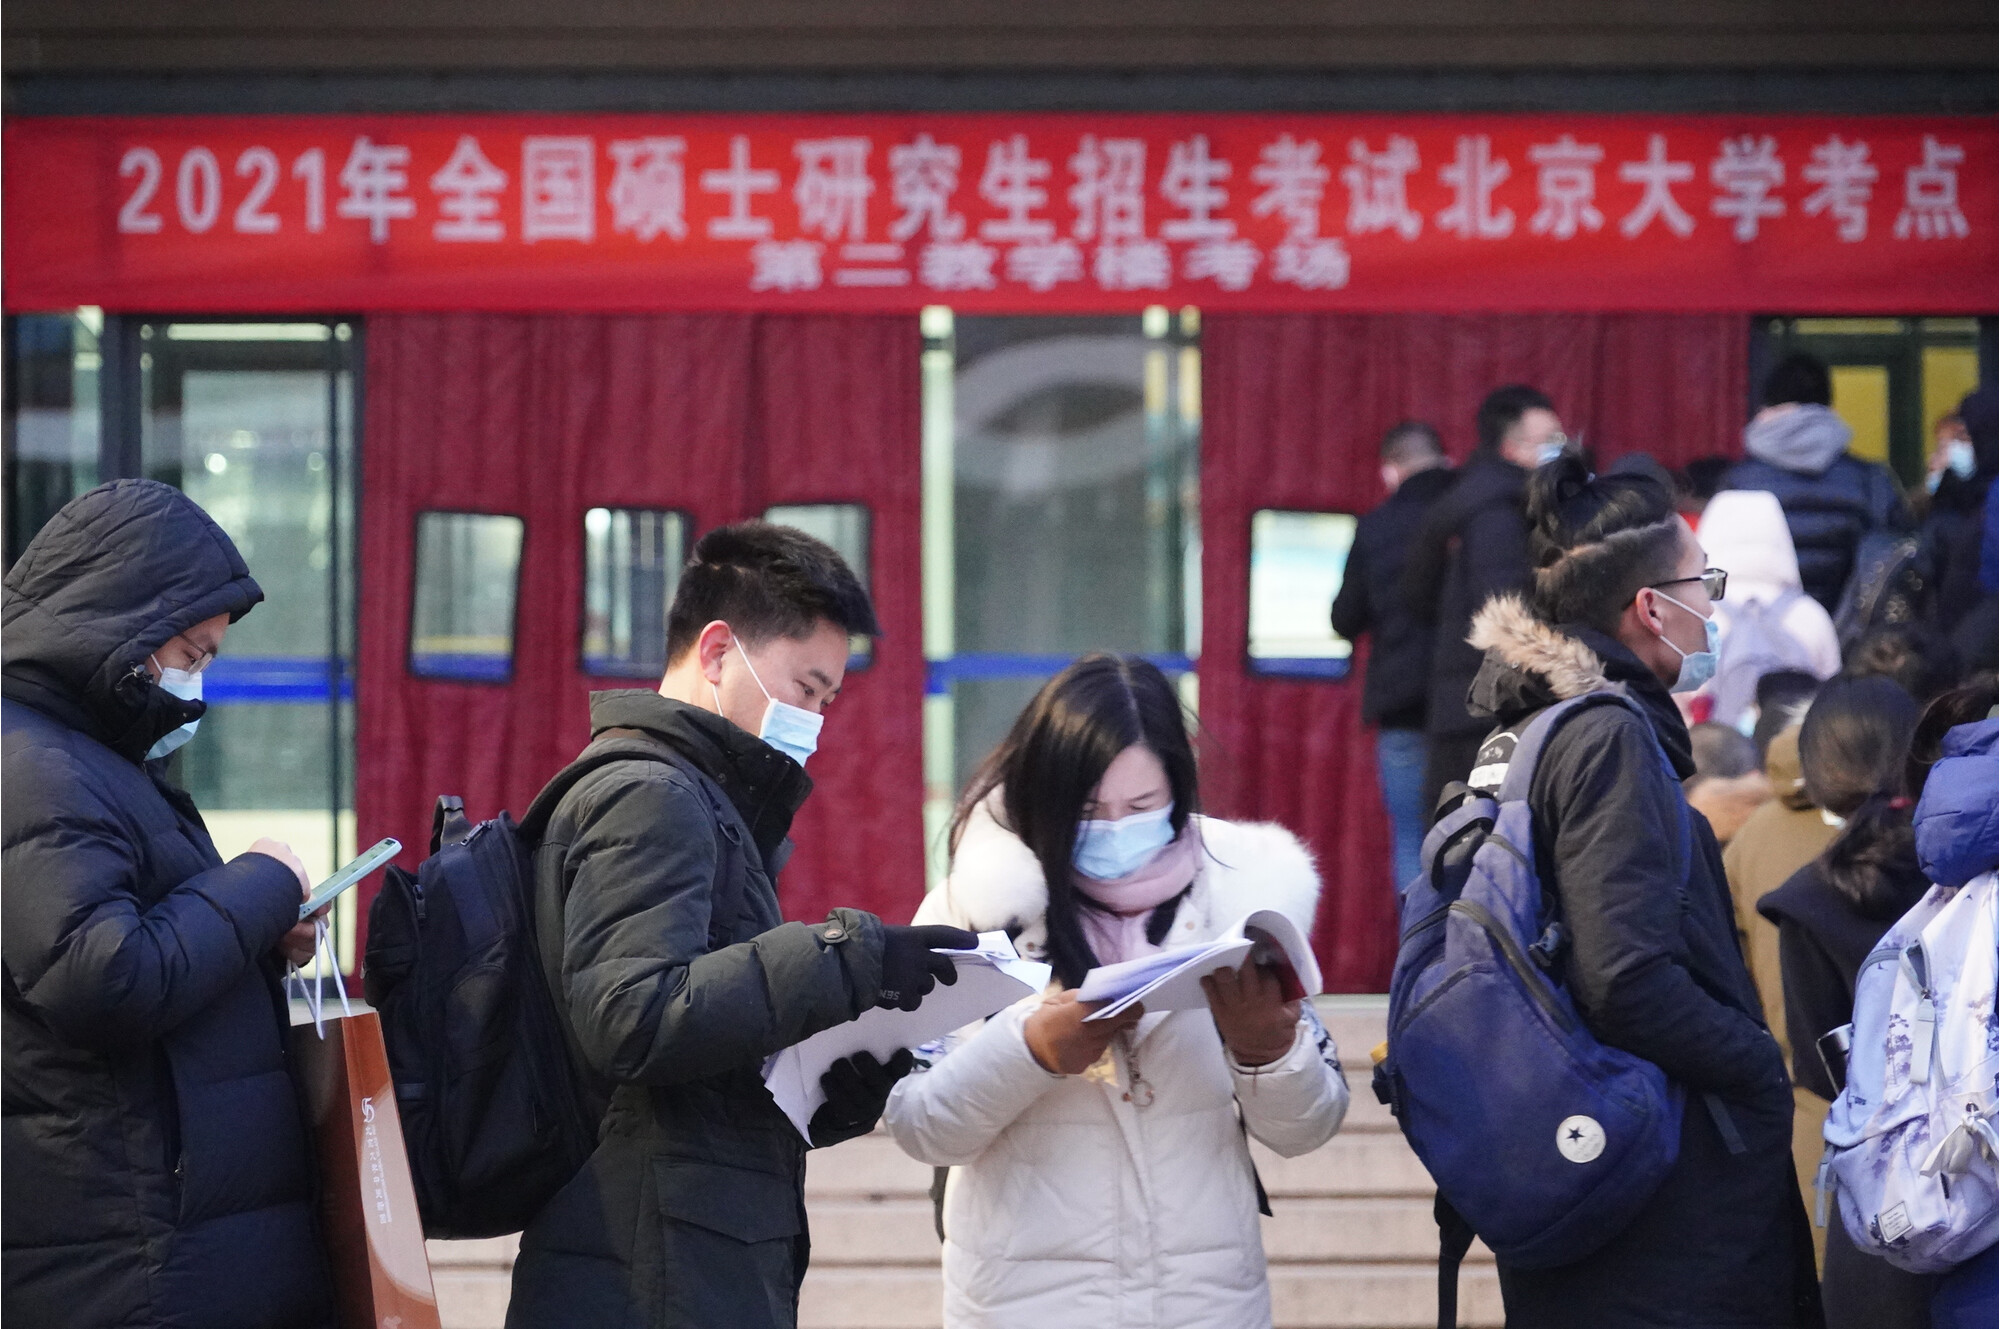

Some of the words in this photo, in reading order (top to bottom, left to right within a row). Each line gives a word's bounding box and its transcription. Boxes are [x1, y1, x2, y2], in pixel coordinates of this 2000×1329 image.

[117, 133, 1971, 243] 2021年全国硕士研究生招生考试北京大学考点
[750, 239, 1351, 292] 第二教学楼考场
